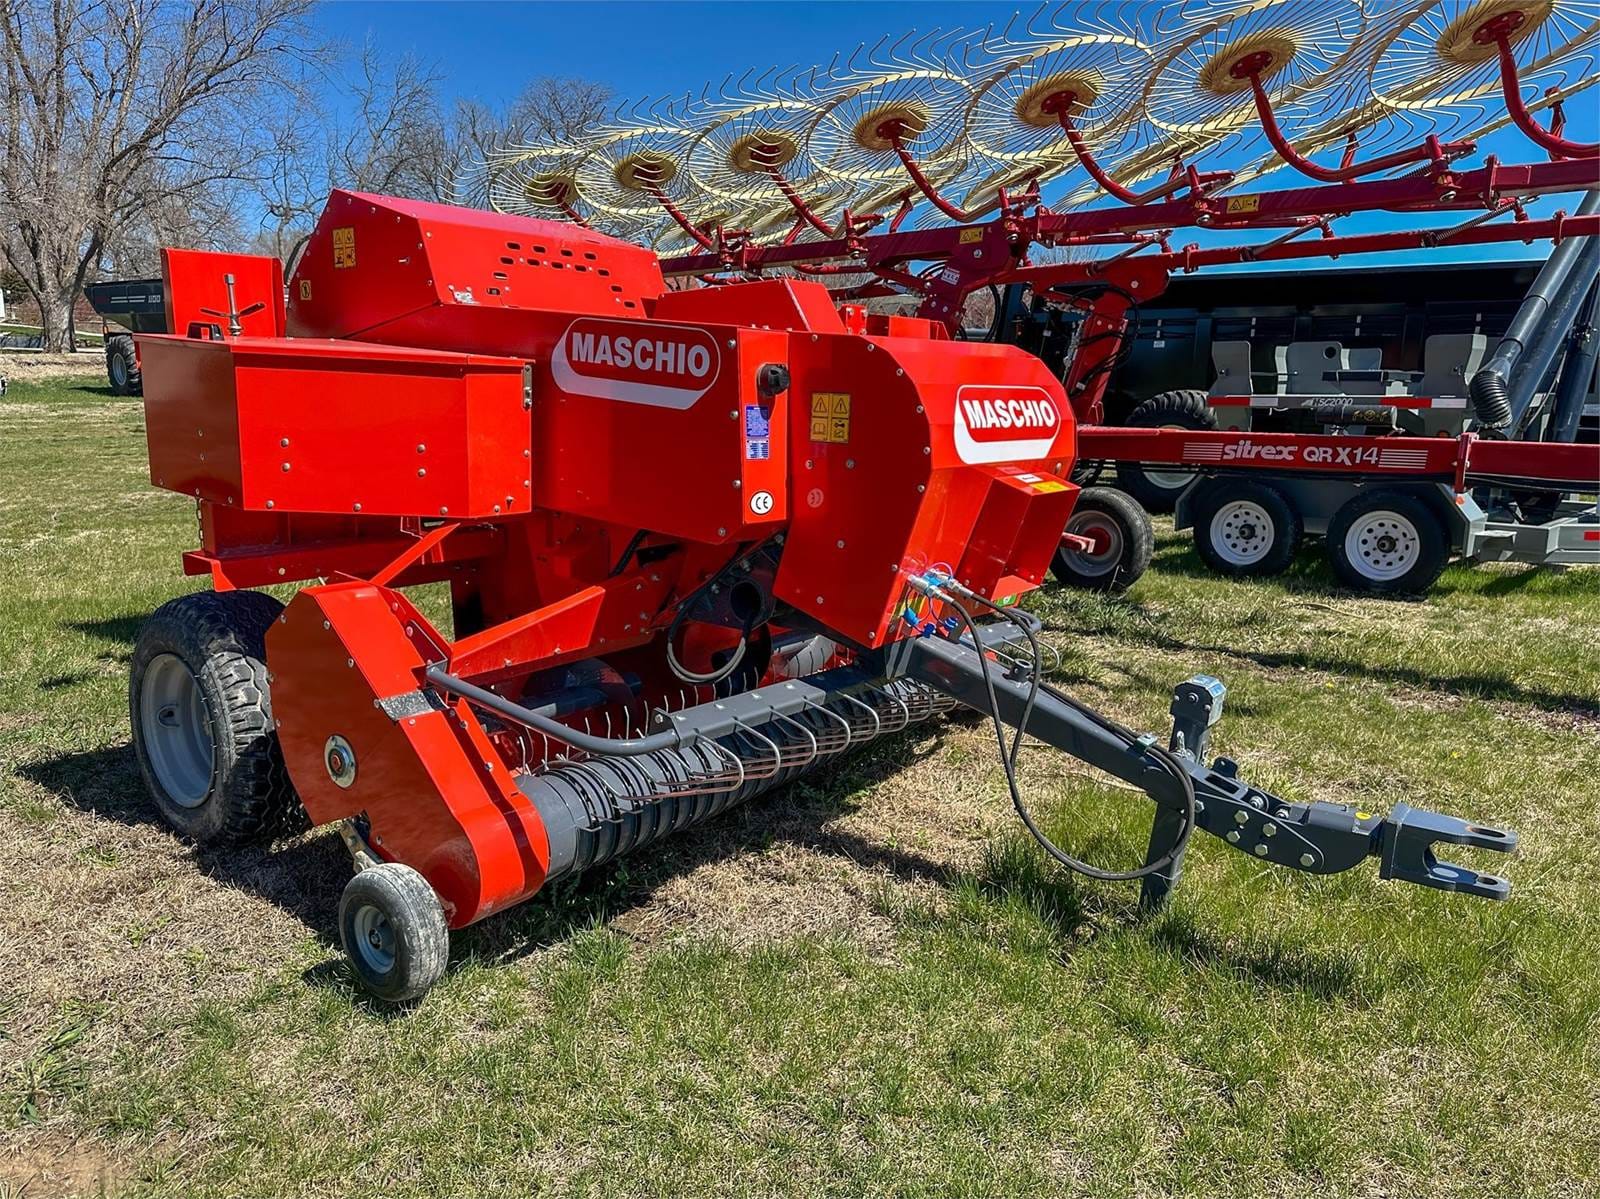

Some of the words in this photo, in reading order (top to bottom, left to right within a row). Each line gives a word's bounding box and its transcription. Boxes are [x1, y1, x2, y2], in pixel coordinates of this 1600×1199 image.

[572, 332, 710, 377] MASCHIO
[962, 399, 1055, 428] MASCHIO
[1222, 440, 1298, 460] sitrex
[755, 495, 769, 510] CE
